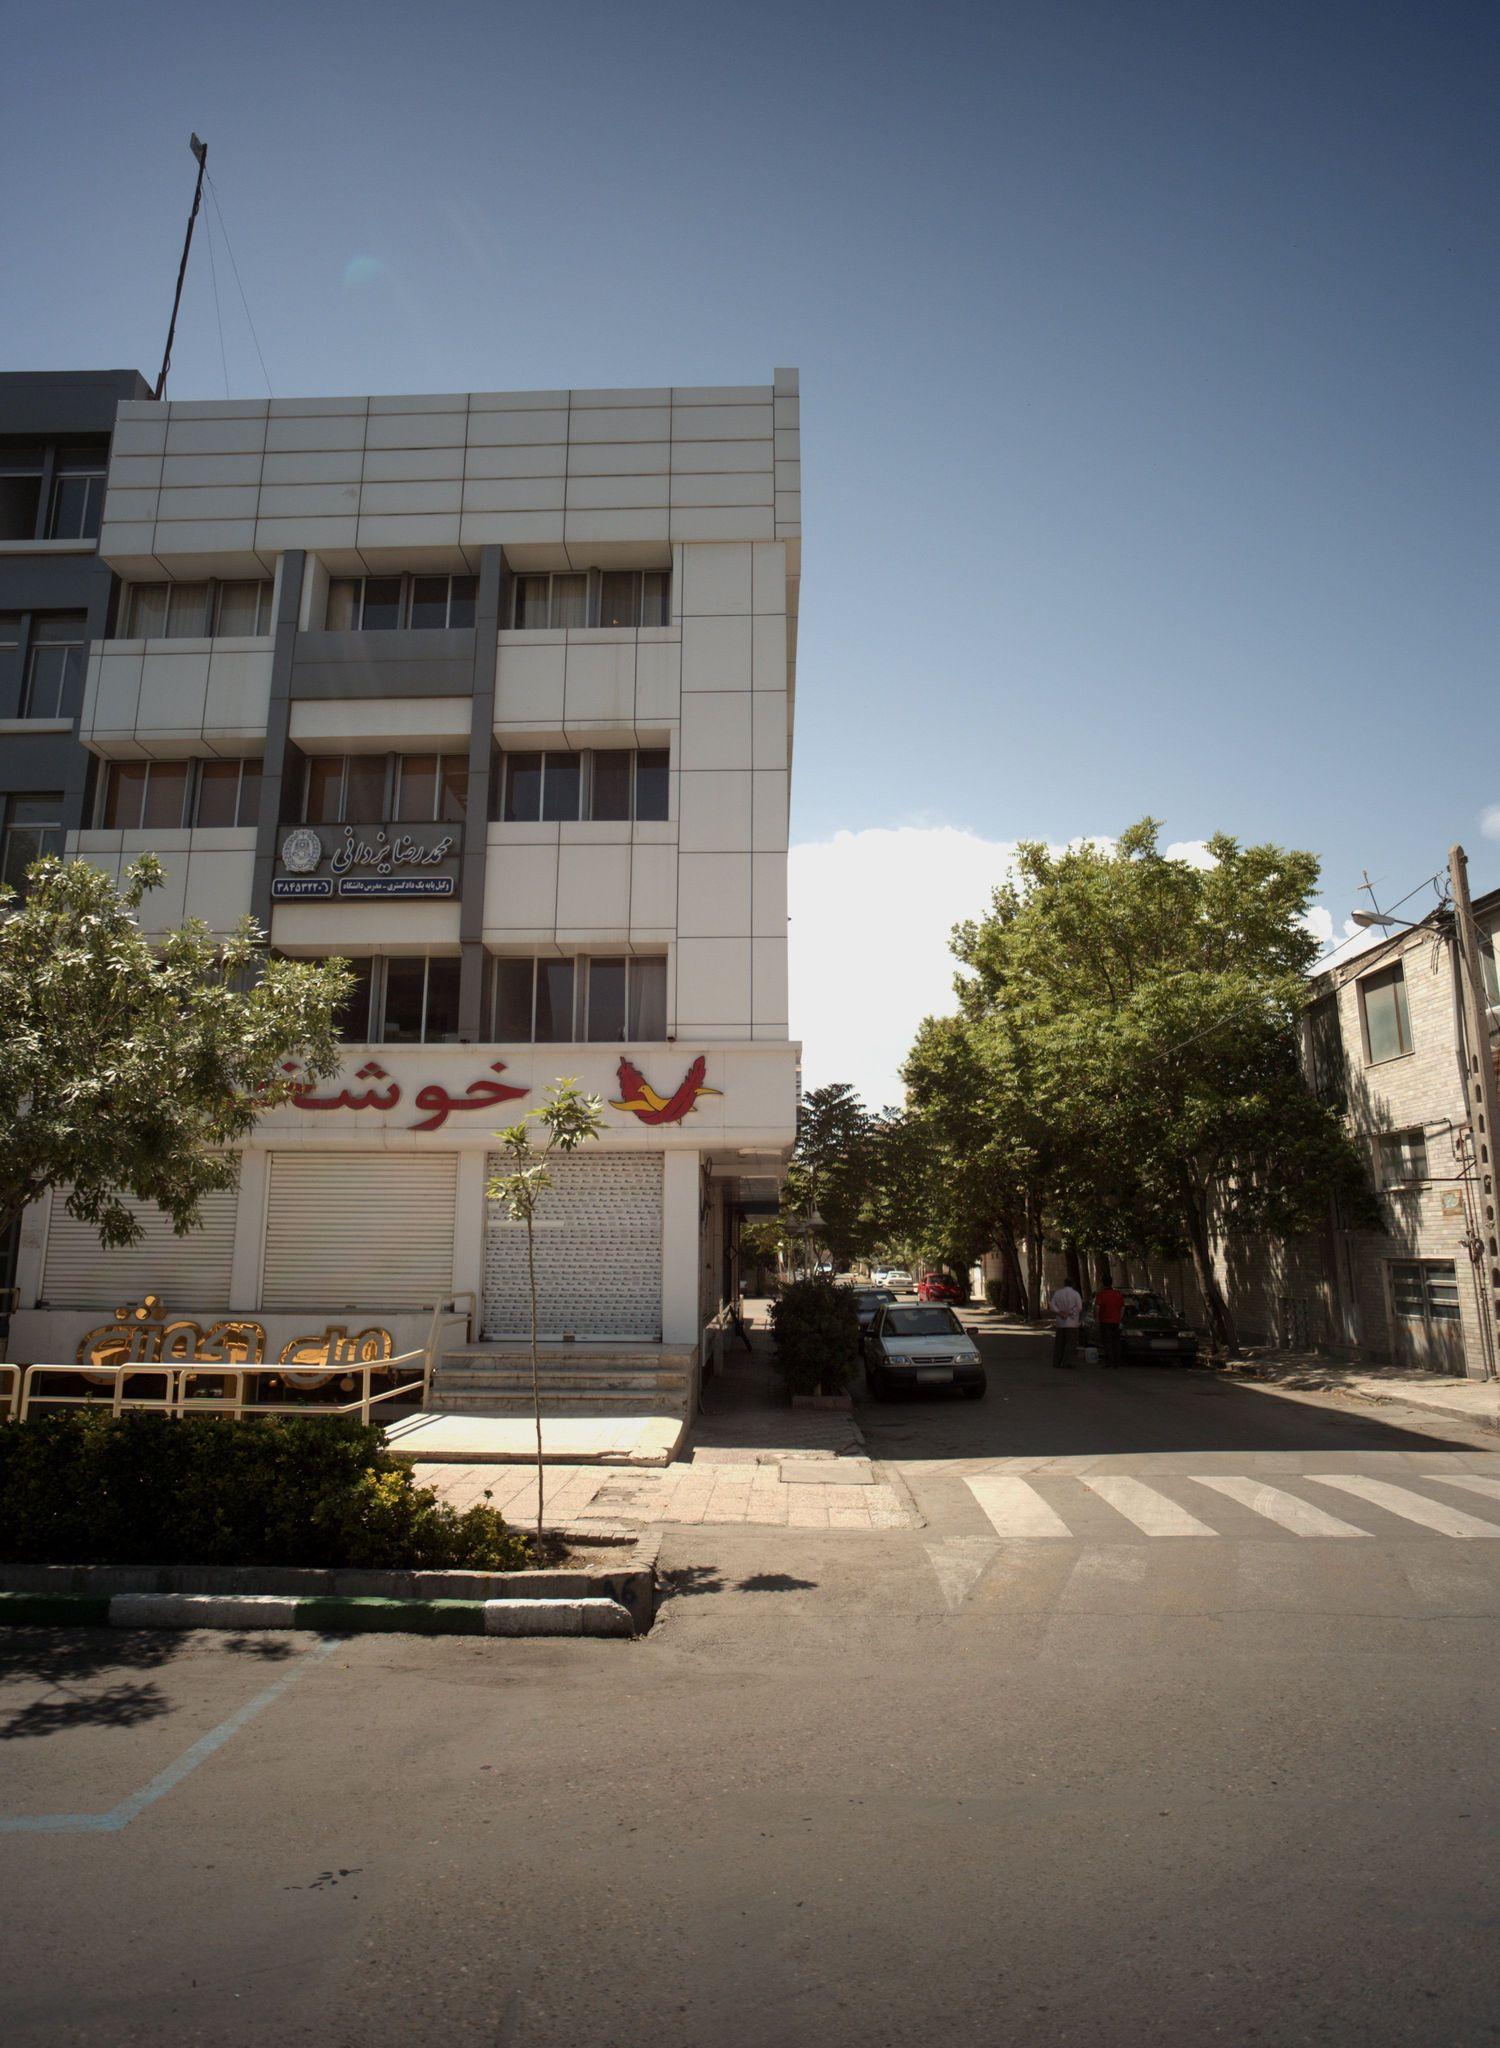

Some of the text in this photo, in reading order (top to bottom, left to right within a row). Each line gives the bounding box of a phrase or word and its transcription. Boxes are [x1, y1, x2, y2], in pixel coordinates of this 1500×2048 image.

[331, 826, 391, 874] یزدانی
[343, 881, 364, 890] دانشگاه
[387, 881, 415, 891] دادگستری
